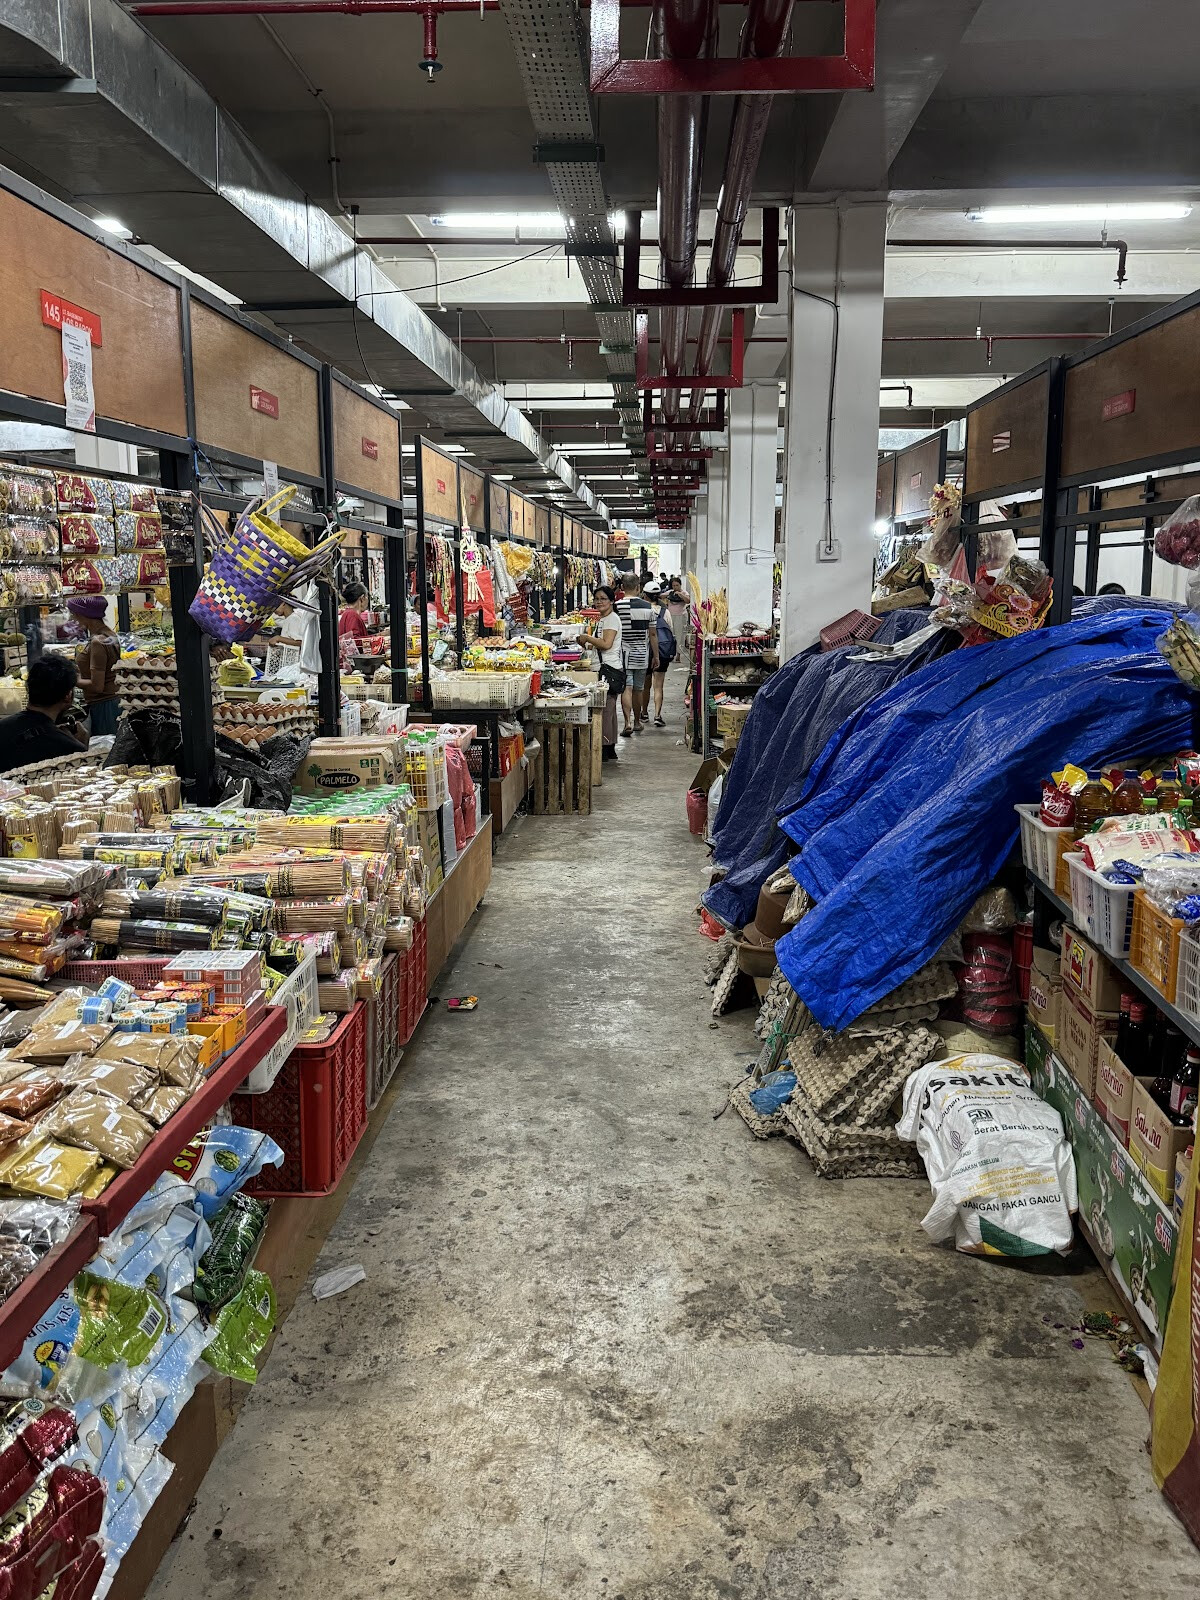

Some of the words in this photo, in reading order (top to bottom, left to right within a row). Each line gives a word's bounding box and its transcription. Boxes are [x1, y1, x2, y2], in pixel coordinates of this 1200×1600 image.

[44, 301, 60, 323] 145
[320, 775, 358, 785] PALMELO
[1101, 1060, 1124, 1098] Sabrina
[967, 1108, 993, 1120] SNI
[974, 1125, 1000, 1135] Berat
[1002, 1124, 1030, 1132] Bersih
[963, 1201, 1000, 1212] JANGAN
[1002, 1198, 1027, 1210] PAKAI
[1029, 1194, 1061, 1205] GANCU
